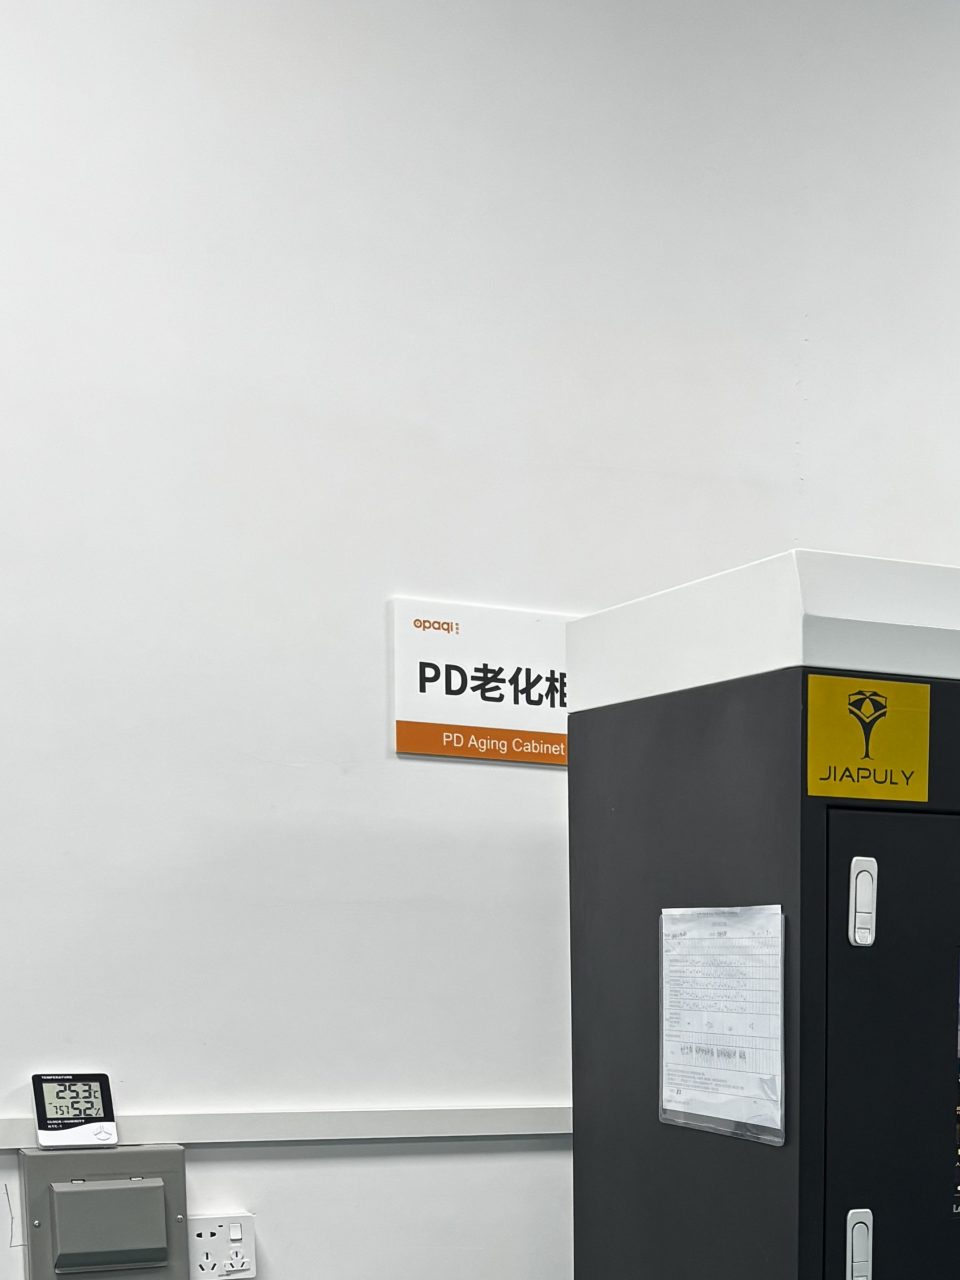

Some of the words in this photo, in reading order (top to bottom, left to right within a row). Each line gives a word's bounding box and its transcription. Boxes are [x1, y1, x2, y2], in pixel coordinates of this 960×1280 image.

[413, 618, 453, 634] opaqi
[442, 732, 464, 747] PD
[468, 734, 508, 754] Aging
[512, 738, 565, 755] Cabinet
[819, 765, 915, 787] JIAPULY
